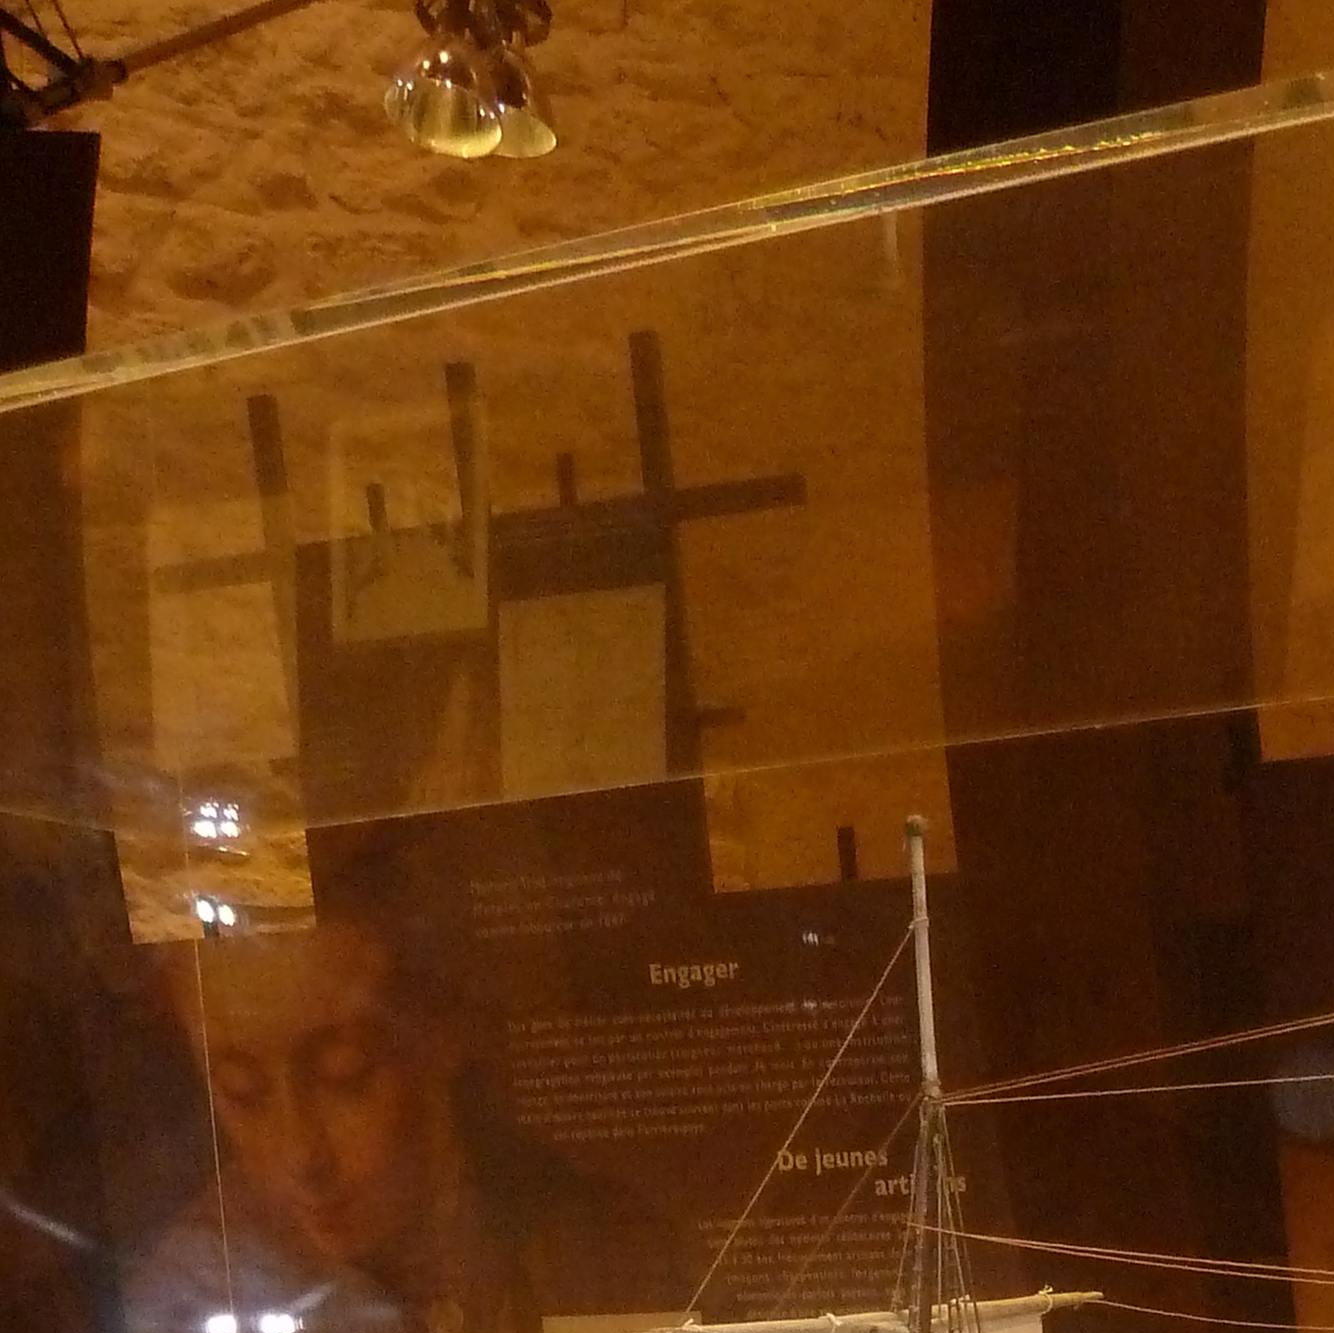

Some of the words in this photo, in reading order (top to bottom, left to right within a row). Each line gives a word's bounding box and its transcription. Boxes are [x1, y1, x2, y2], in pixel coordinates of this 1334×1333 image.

[649, 962, 739, 989] Engager
[777, 1150, 807, 1172] De
[815, 1147, 888, 1176] jeunes
[874, 1173, 967, 1197] artins
